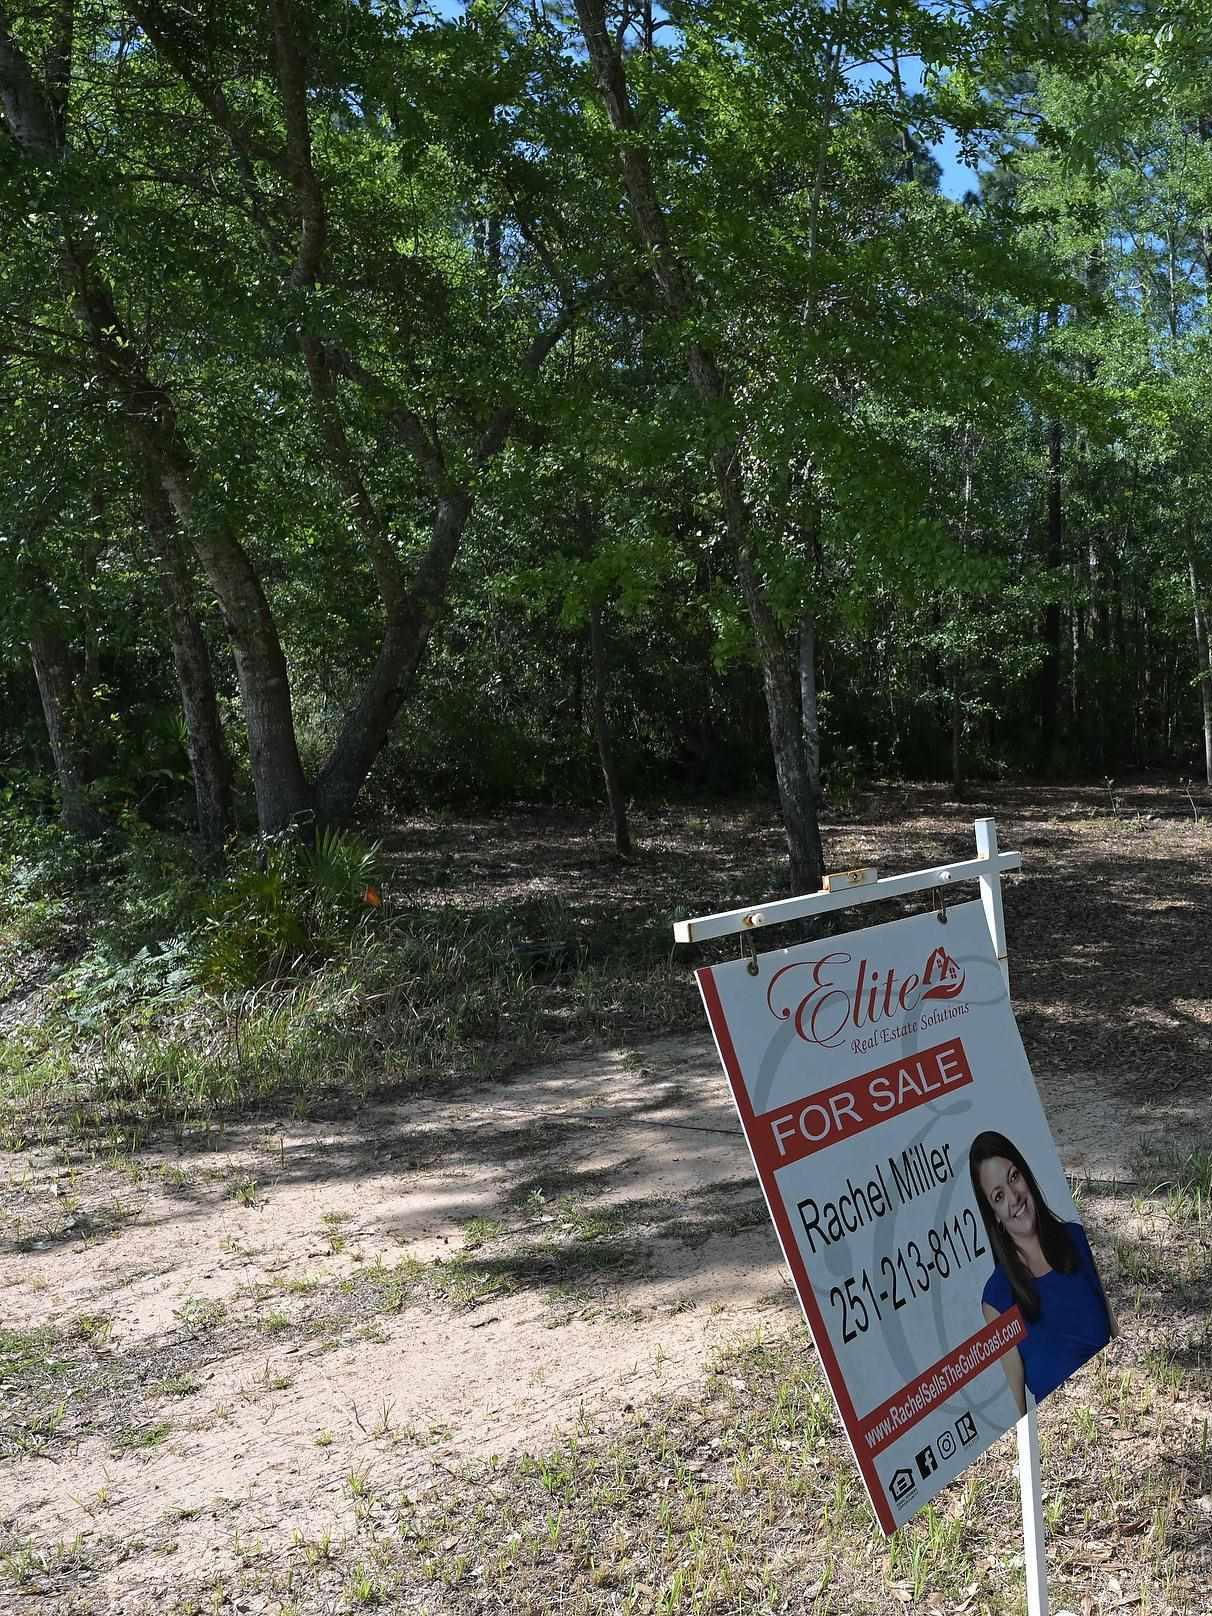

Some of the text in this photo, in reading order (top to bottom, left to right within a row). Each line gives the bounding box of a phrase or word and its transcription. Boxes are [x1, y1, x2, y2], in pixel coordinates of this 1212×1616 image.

[767, 952, 922, 1048] Elite
[850, 1001, 970, 1055] Real Estate Solutions
[770, 1048, 963, 1157] FOR SALE
[797, 1142, 955, 1253] Rachel Miller
[830, 1207, 986, 1345] 251-213-8112
[864, 1317, 1022, 1449] www.RachelSellsTheGulfCoast.com
